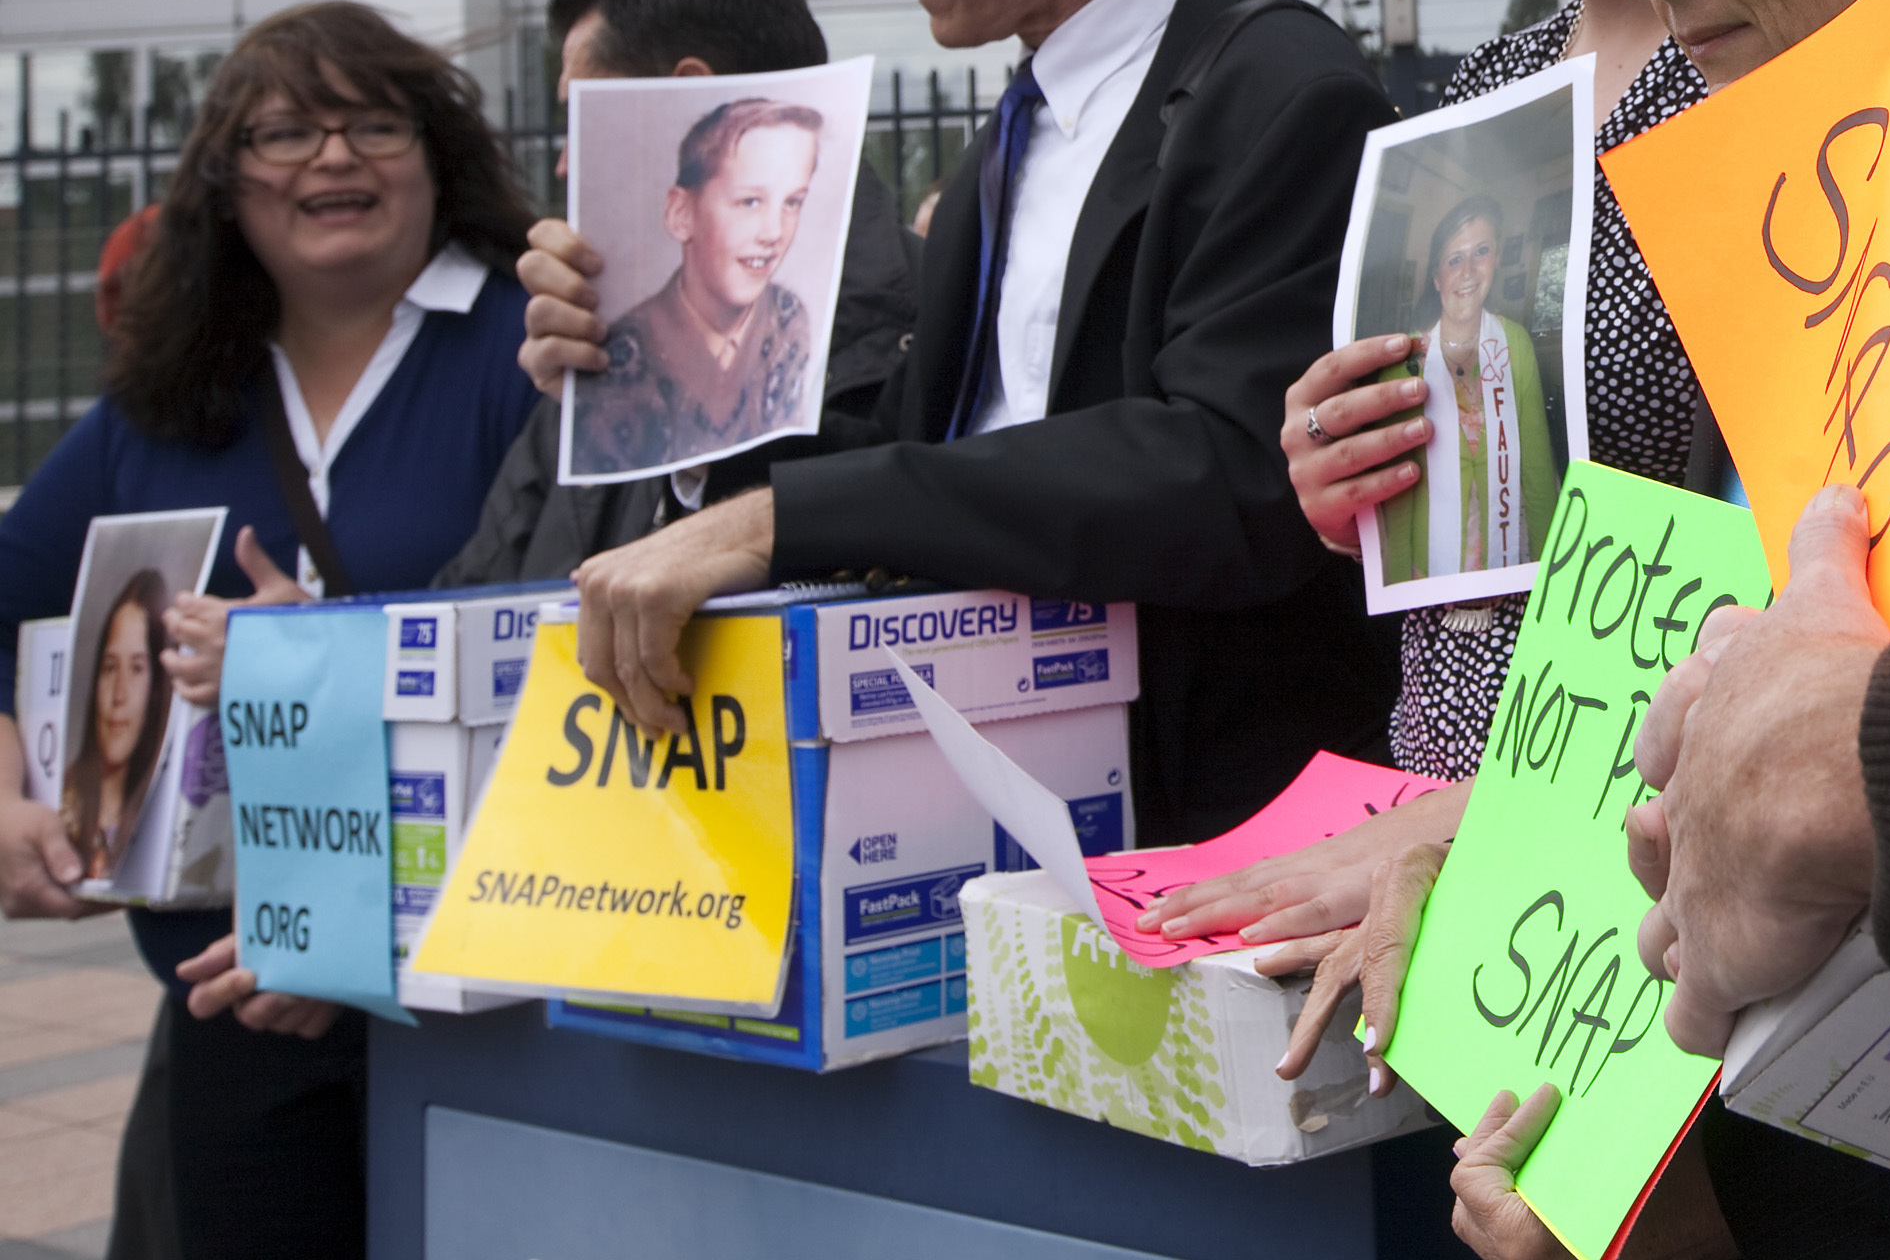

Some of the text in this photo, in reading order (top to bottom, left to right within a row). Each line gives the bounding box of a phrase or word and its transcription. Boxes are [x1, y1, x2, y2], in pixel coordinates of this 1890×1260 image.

[226, 700, 309, 748] SNAP
[545, 693, 747, 792] SNAP
[1496, 659, 1609, 785] NOT
[239, 804, 383, 857] NETWORK
[862, 832, 898, 851] OPEN
[862, 846, 897, 866] HERE
[468, 870, 746, 930] SNAPnetwork.org
[859, 889, 921, 916] FastPack
[248, 902, 312, 952] .ORG
[1473, 889, 1664, 1098] SNAP
